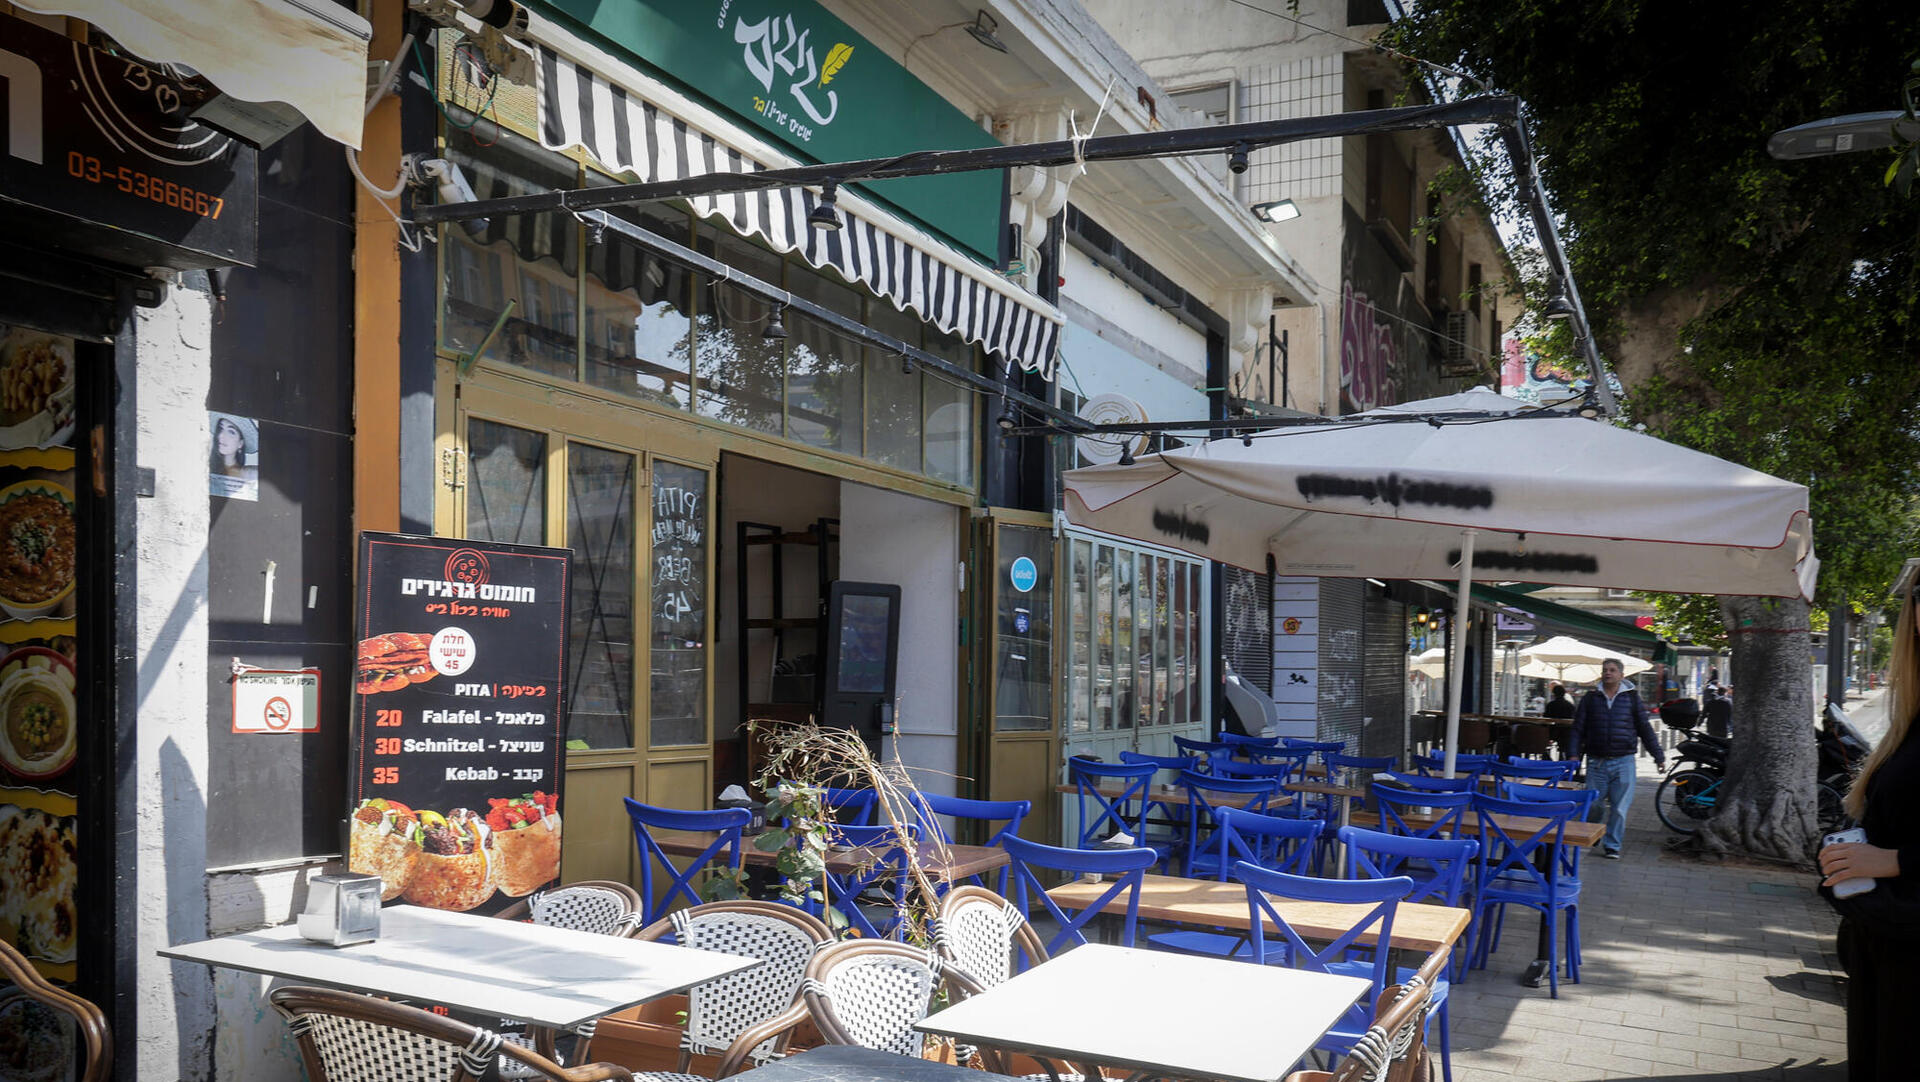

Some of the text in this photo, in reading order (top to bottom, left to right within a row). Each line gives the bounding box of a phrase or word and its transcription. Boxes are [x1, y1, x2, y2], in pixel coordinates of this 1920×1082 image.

[68, 151, 224, 220] 03-5366667
[401, 578, 536, 603] חומוס גרגירים
[425, 602, 448, 616] ביס
[481, 606, 511, 618] חוויה
[442, 635, 464, 644] חלת
[440, 647, 466, 658] שישי
[445, 660, 459, 669] 45
[454, 683, 491, 697] PITA
[376, 709, 403, 727] 20
[422, 709, 482, 725] Falafel
[495, 711, 546, 726] פלאפל
[374, 737, 401, 755] 30
[404, 737, 485, 753] Schnitzel
[499, 738, 545, 753] שניצל
[372, 766, 400, 784] 35
[445, 766, 499, 781] Kebab
[512, 768, 544, 783] קבב
